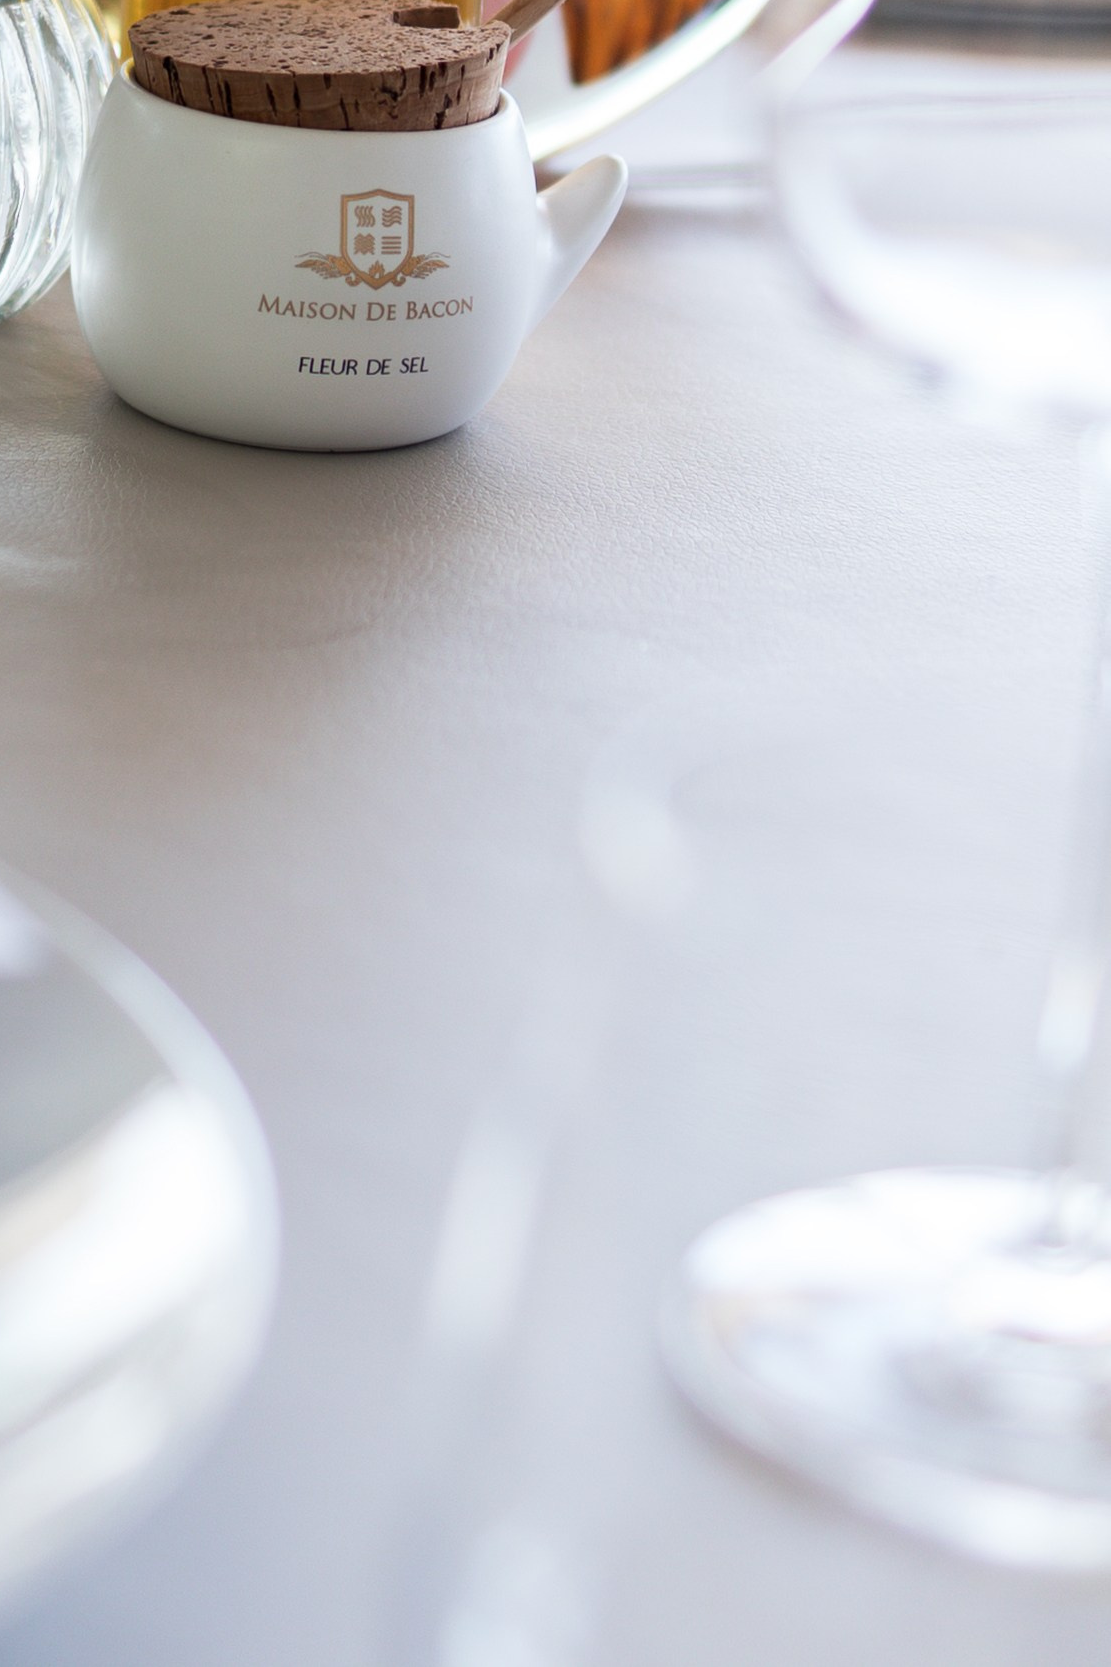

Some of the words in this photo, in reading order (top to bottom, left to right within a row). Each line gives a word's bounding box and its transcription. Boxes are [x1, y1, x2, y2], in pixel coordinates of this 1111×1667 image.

[257, 293, 357, 321] MAISON
[366, 301, 397, 322] DE
[405, 296, 474, 321] BACON
[298, 356, 358, 376] FLEUR
[366, 358, 392, 376] DE
[399, 356, 429, 374] SEL
